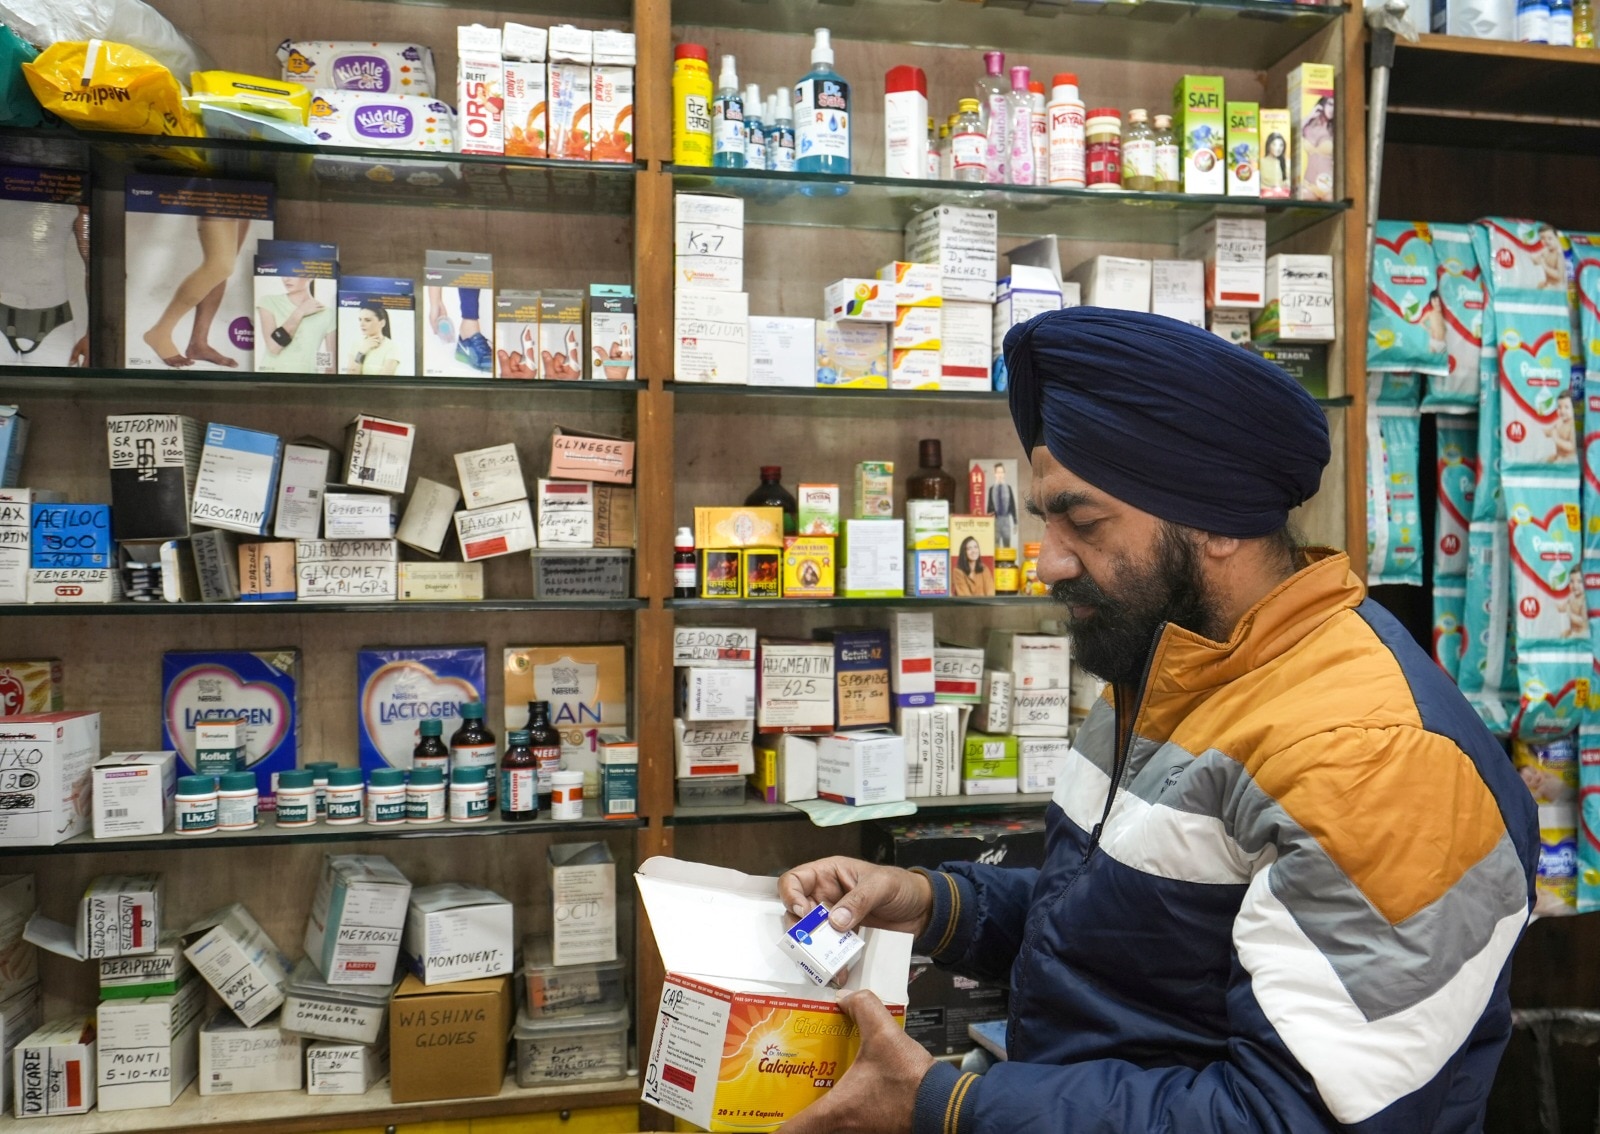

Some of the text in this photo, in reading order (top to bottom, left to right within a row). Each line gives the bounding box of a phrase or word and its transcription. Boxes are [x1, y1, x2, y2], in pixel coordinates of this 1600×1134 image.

[336, 61, 383, 82] Kiddle
[1189, 93, 1219, 108] SAFI
[357, 109, 406, 126] Kiddle
[379, 123, 406, 134] care
[943, 265, 987, 278] SACHETS
[1281, 294, 1333, 308] CIPZEN
[108, 415, 179, 434] METFORMIN
[114, 437, 131, 446] SR
[161, 436, 178, 446] SR
[554, 438, 622, 456] GLYNEESE
[112, 450, 134, 459] 500
[162, 449, 183, 457] 1000
[33, 509, 108, 529] ACILOC
[193, 501, 263, 523] VASOGRAIN
[460, 510, 522, 535] LANOXIN
[298, 542, 393, 559] DIANORM-M
[300, 565, 384, 580] GLYCOMET
[920, 559, 938, 578] P-6
[1523, 598, 1537, 612] M
[763, 656, 831, 674] AUGMENTIN
[782, 679, 816, 697] 625
[1014, 695, 1068, 708] NOVAMOX
[380, 701, 462, 723] LACTOGEN
[548, 702, 602, 724] AN
[1028, 710, 1050, 721] 500
[585, 729, 598, 752] 1
[682, 729, 750, 744] CEFIXIME
[201, 751, 231, 761] Koflet
[701, 745, 724, 757] CV
[933, 711, 944, 797] NITROFURANTOIN
[330, 802, 357, 814] Pilex
[186, 811, 216, 823] Liv.52
[121, 895, 135, 951] SILDOSIN
[339, 929, 399, 942] METROGYL
[799, 961, 823, 984] D3-HIGH
[224, 973, 253, 1000] MONTI
[662, 988, 684, 1011] CAP
[400, 1008, 486, 1028] WASHING
[415, 1030, 478, 1048] GLOVES
[112, 1053, 160, 1064] MONTI
[307, 1049, 361, 1060] EBASTINE
[24, 1049, 41, 1112] URICARE
[814, 1079, 826, 1087] 60
[755, 1110, 784, 1118] Capsules
